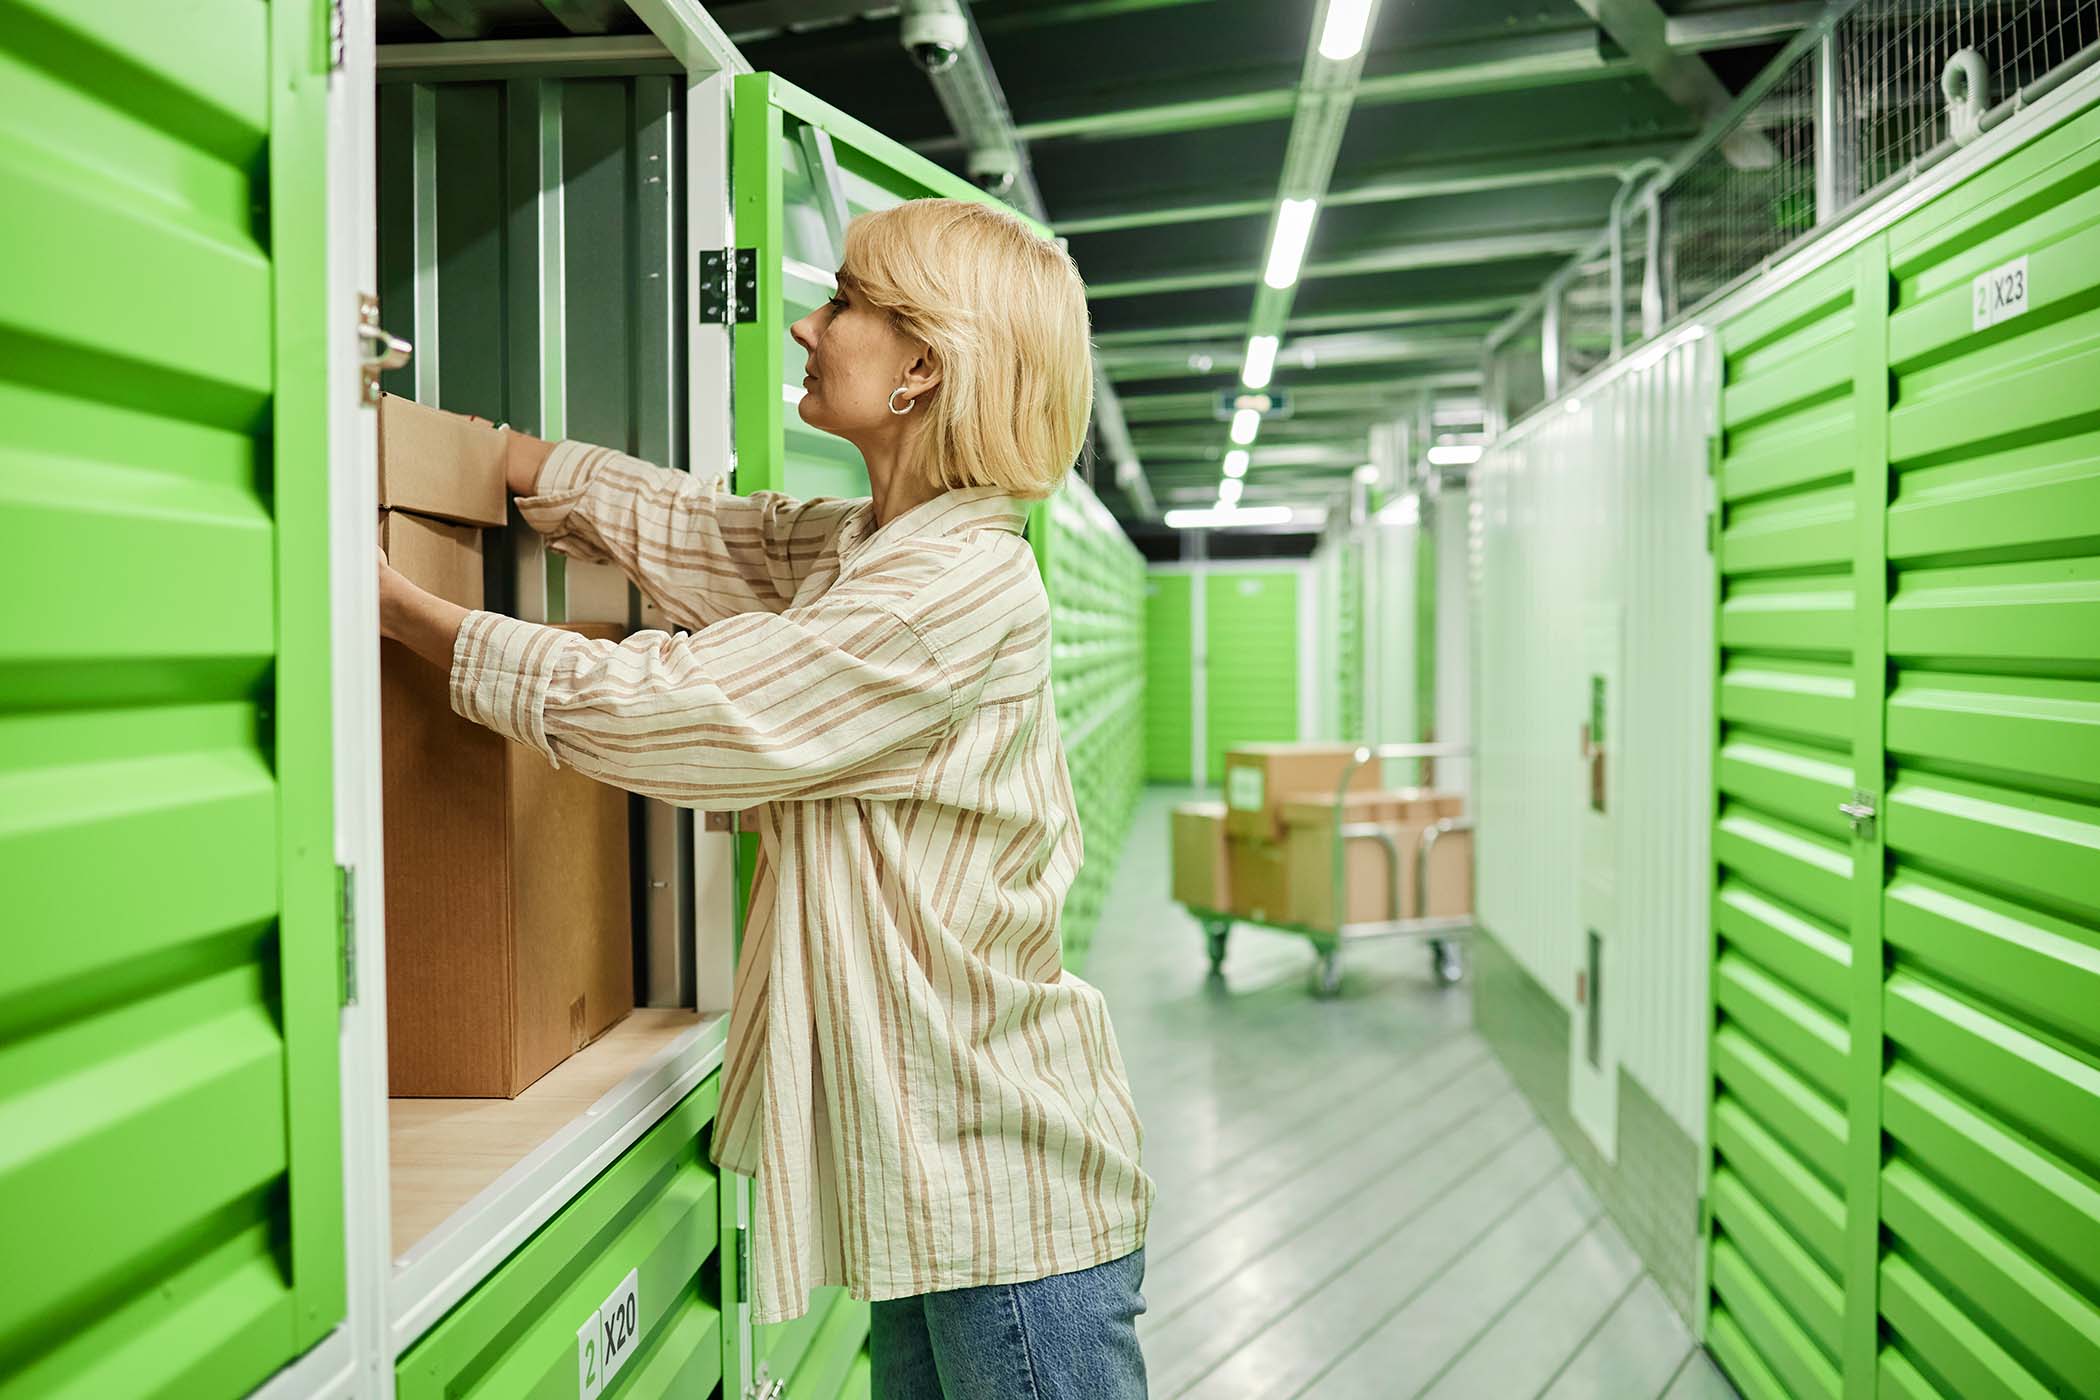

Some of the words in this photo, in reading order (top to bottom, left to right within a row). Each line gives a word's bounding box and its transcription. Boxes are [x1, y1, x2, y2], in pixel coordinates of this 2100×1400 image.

[1978, 287, 1986, 316] 2
[1995, 269, 2024, 310] X23
[585, 1339, 596, 1389] 2
[604, 1292, 635, 1366] X20
